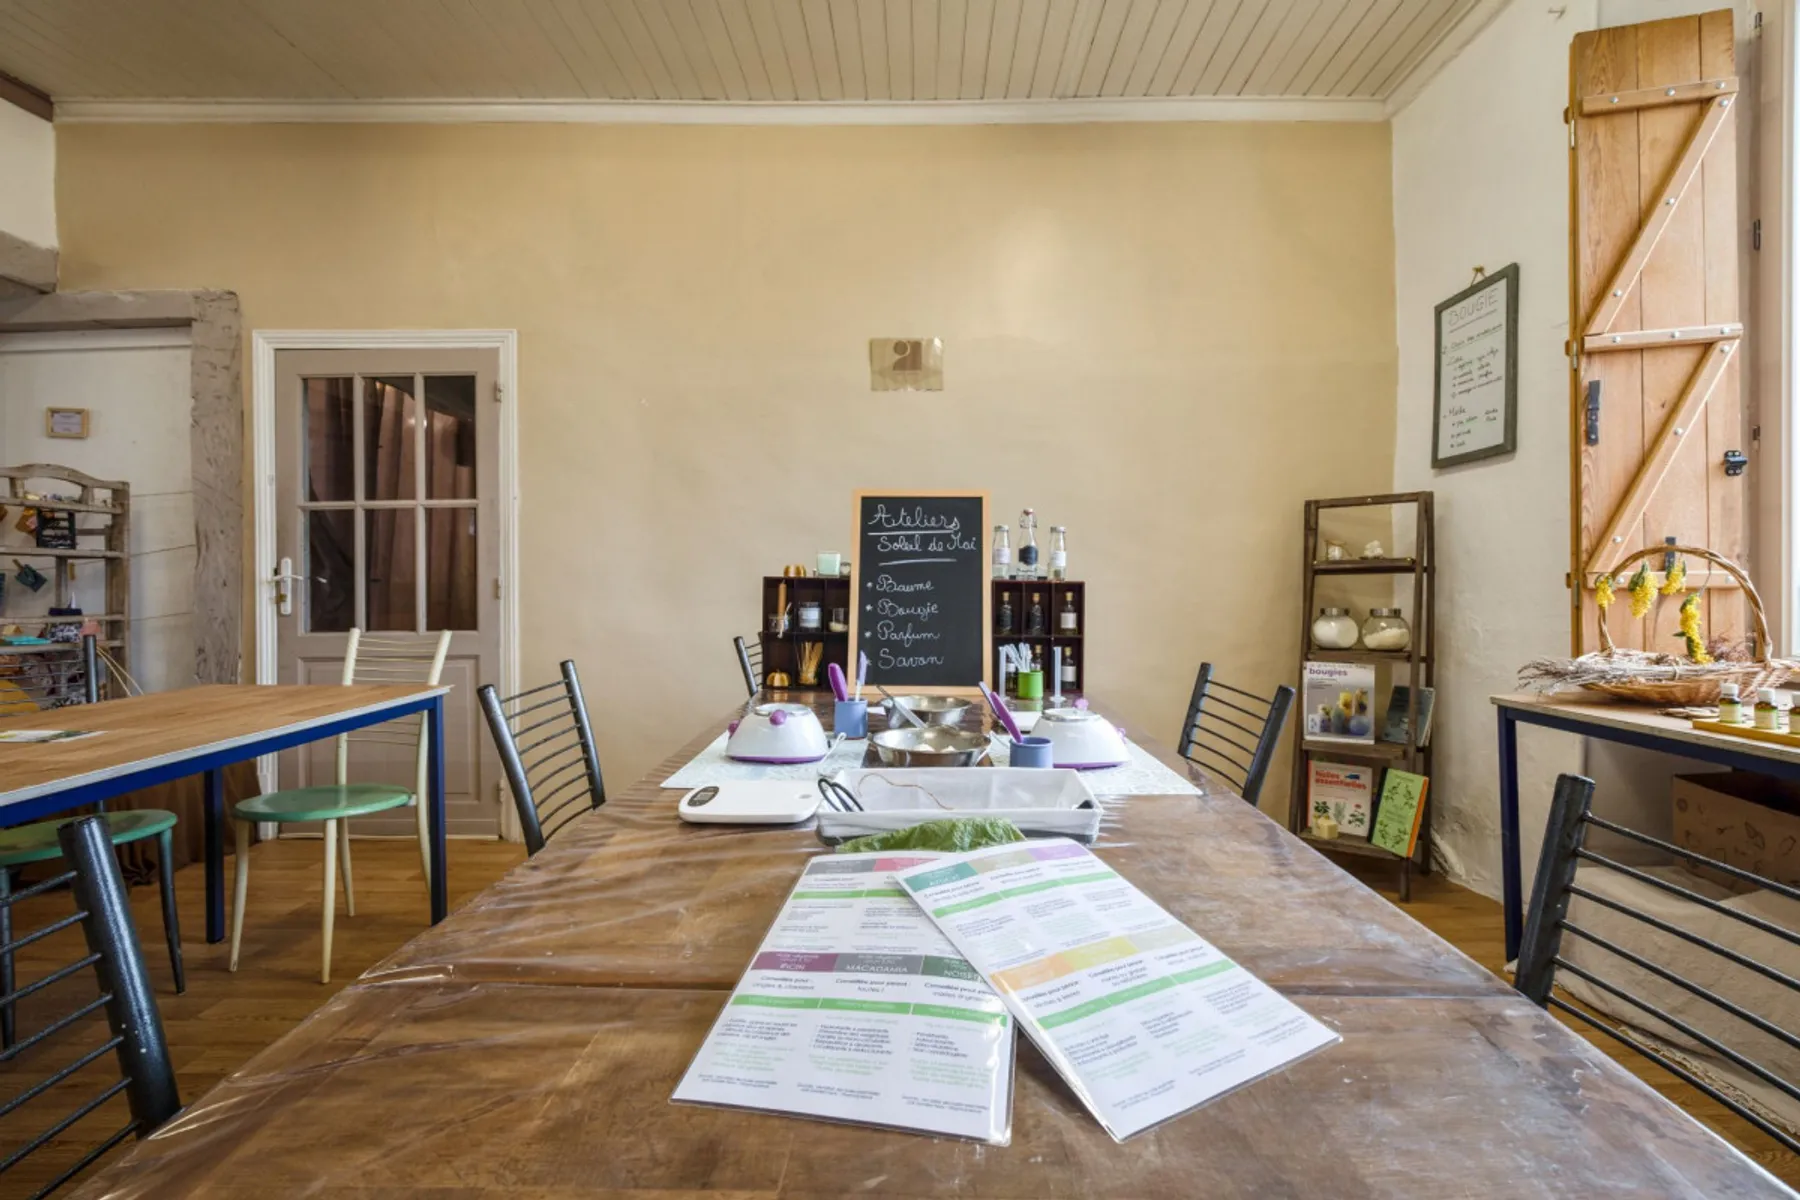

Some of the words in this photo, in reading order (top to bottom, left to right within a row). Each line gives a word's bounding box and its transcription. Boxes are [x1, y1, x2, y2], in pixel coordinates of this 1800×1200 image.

[1448, 287, 1499, 327] BOUGIE
[867, 504, 961, 531] Ateliers
[877, 535, 923, 552] Soleil
[928, 539, 944, 552] de
[876, 574, 935, 593] Baume
[877, 598, 940, 621] Bougie
[877, 620, 941, 647] Parfum
[878, 649, 944, 669] Savon
[1309, 668, 1348, 677] bougies
[845, 963, 909, 974] MACADAMIA
